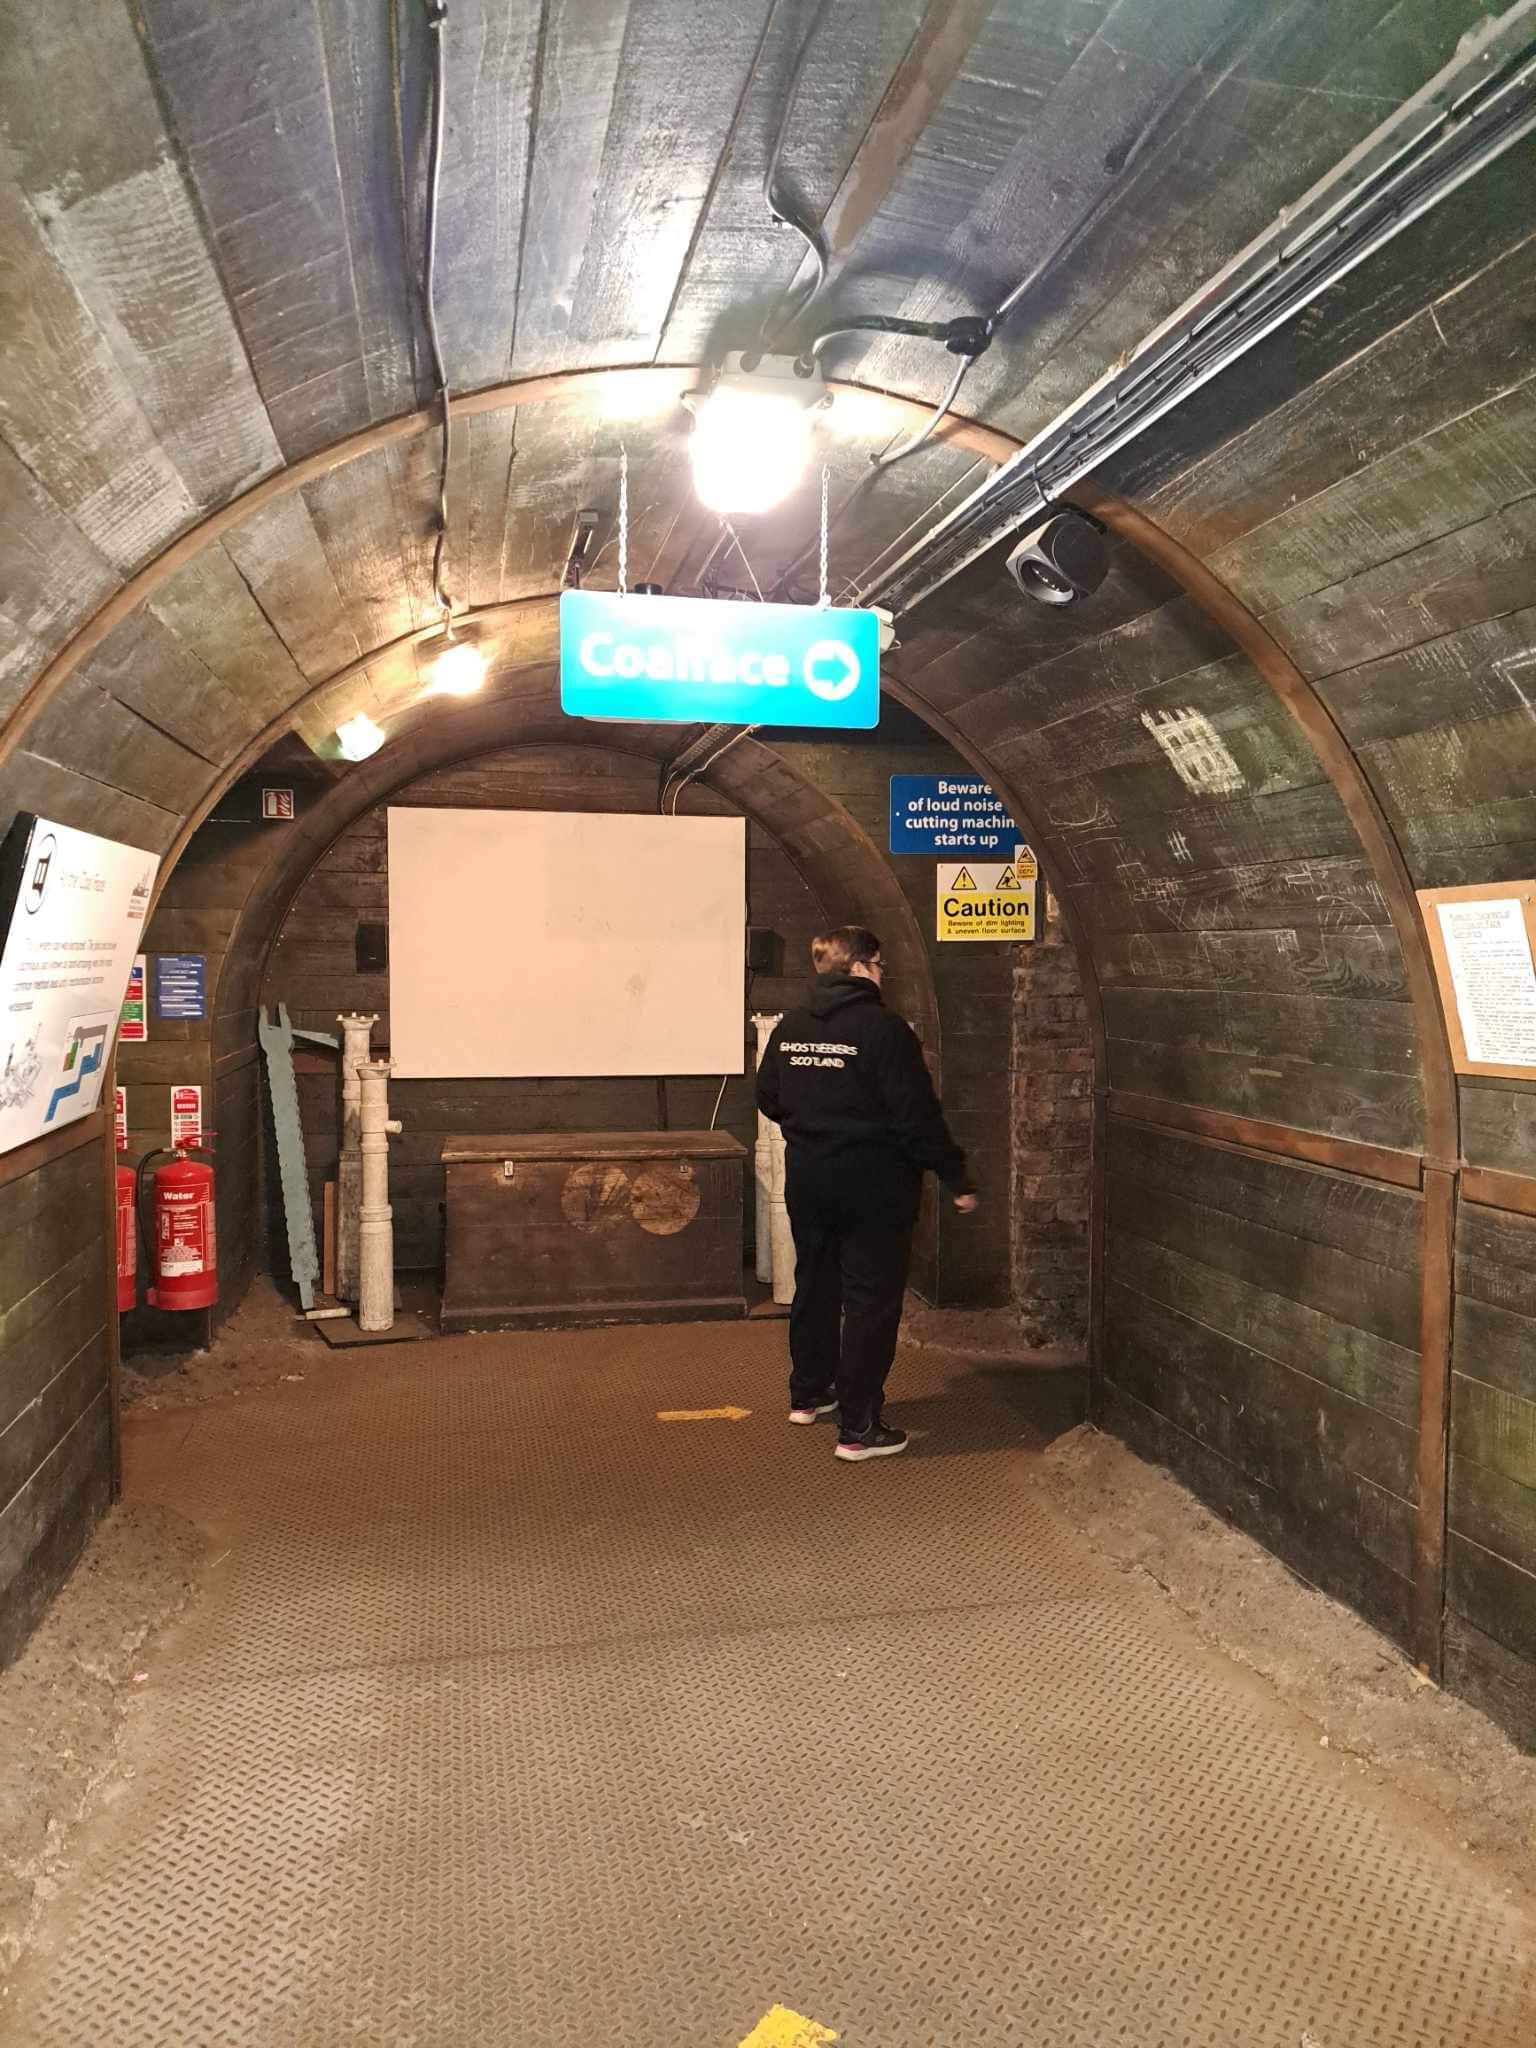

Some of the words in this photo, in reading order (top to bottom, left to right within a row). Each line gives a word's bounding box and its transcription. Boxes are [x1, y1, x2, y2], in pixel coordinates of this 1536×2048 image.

[579, 630, 790, 687] Coalface
[938, 781, 992, 794] Beware
[908, 798, 924, 812] of
[926, 798, 960, 812] loud
[963, 798, 1004, 812] noise
[905, 815, 959, 832] cutting
[962, 815, 1018, 829] machin
[934, 834, 977, 846] starts
[980, 835, 999, 849] up
[944, 897, 1029, 917] Caution
[976, 919, 984, 927] of
[1000, 919, 1025, 928] lighting
[789, 1056, 845, 1068] SCOTLAND
[162, 1191, 195, 1201] Water
